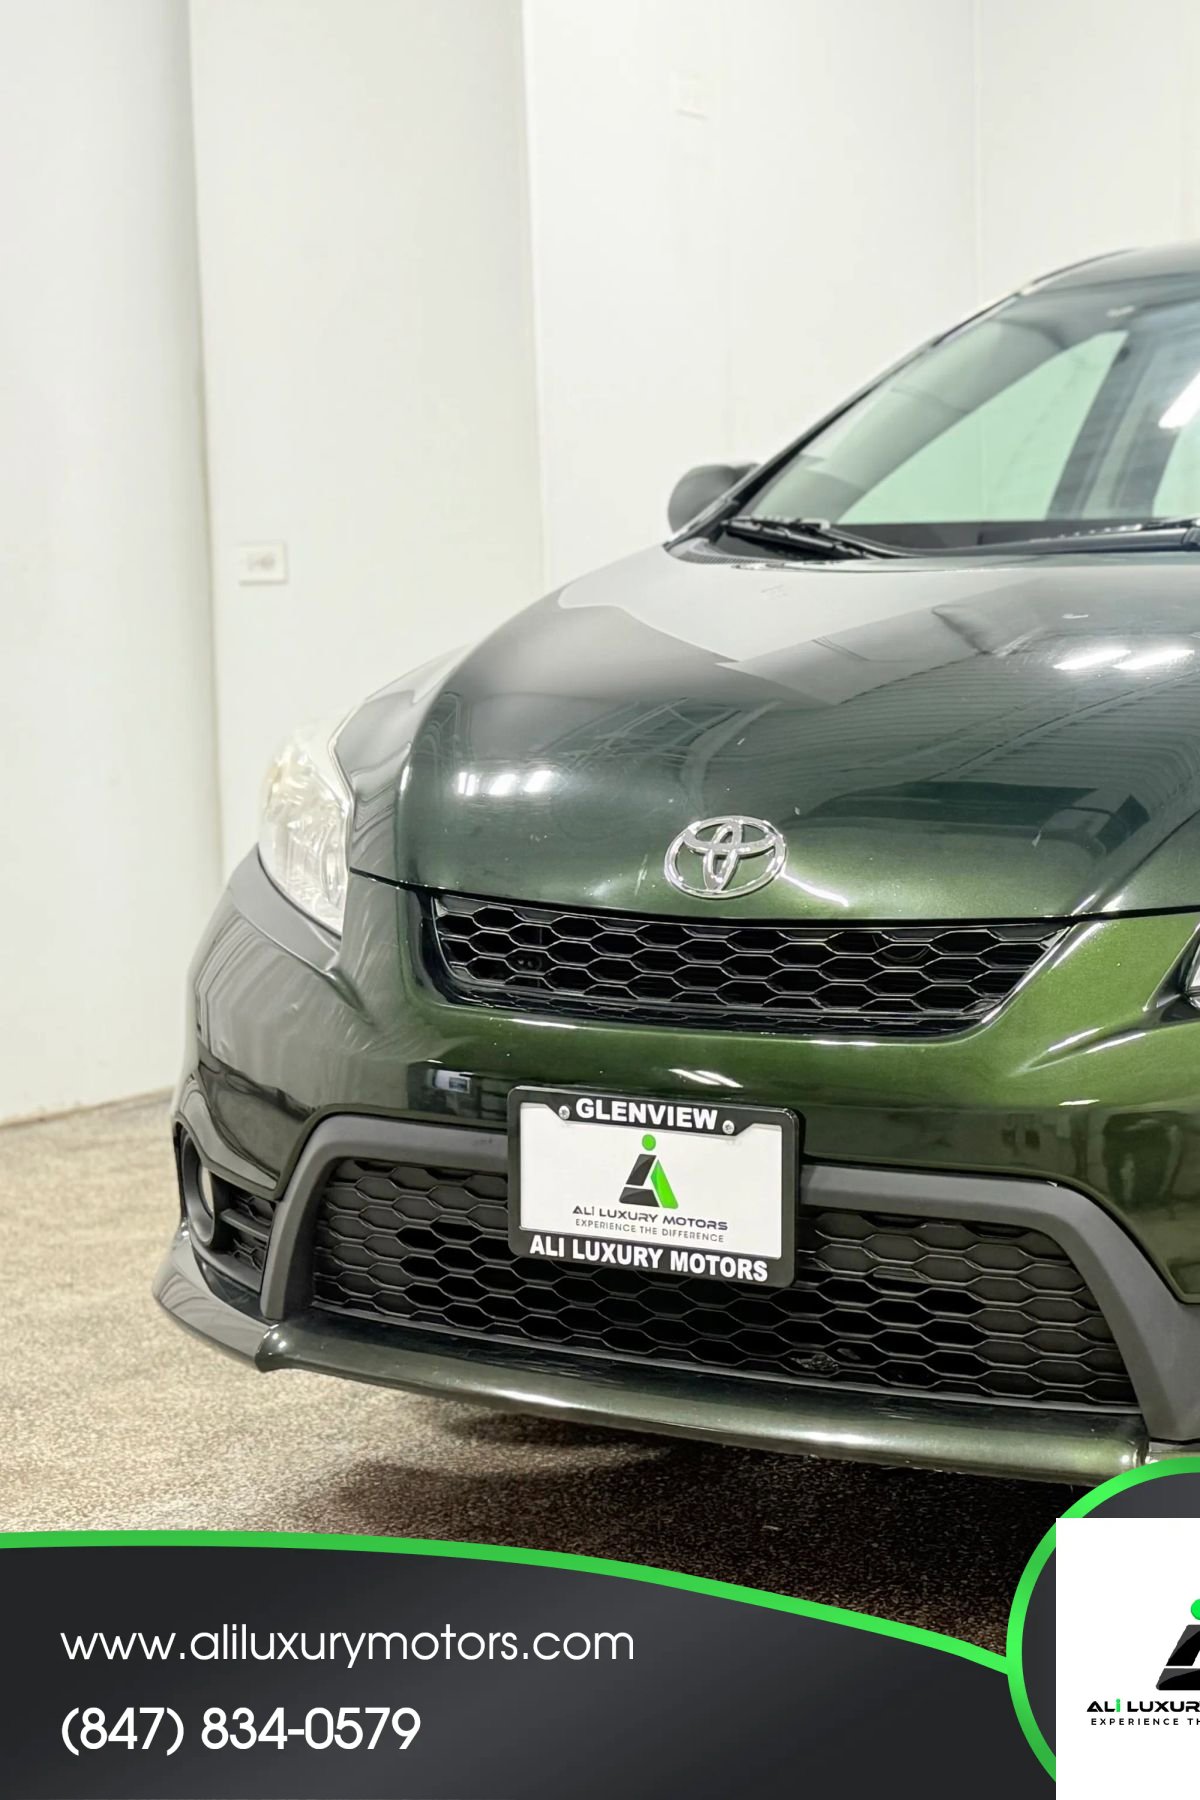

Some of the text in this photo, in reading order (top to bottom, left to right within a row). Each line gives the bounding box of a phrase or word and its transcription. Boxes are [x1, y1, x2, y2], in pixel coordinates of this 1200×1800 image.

[575, 1098, 718, 1130] GLENVIEW
[575, 1218, 724, 1243] EXPERIENCE THE DIFFERENCE
[599, 1208, 659, 1223] LUXURY
[663, 1216, 729, 1231] MOTORS
[529, 1235, 768, 1282] ALI LUXURY MOTORS
